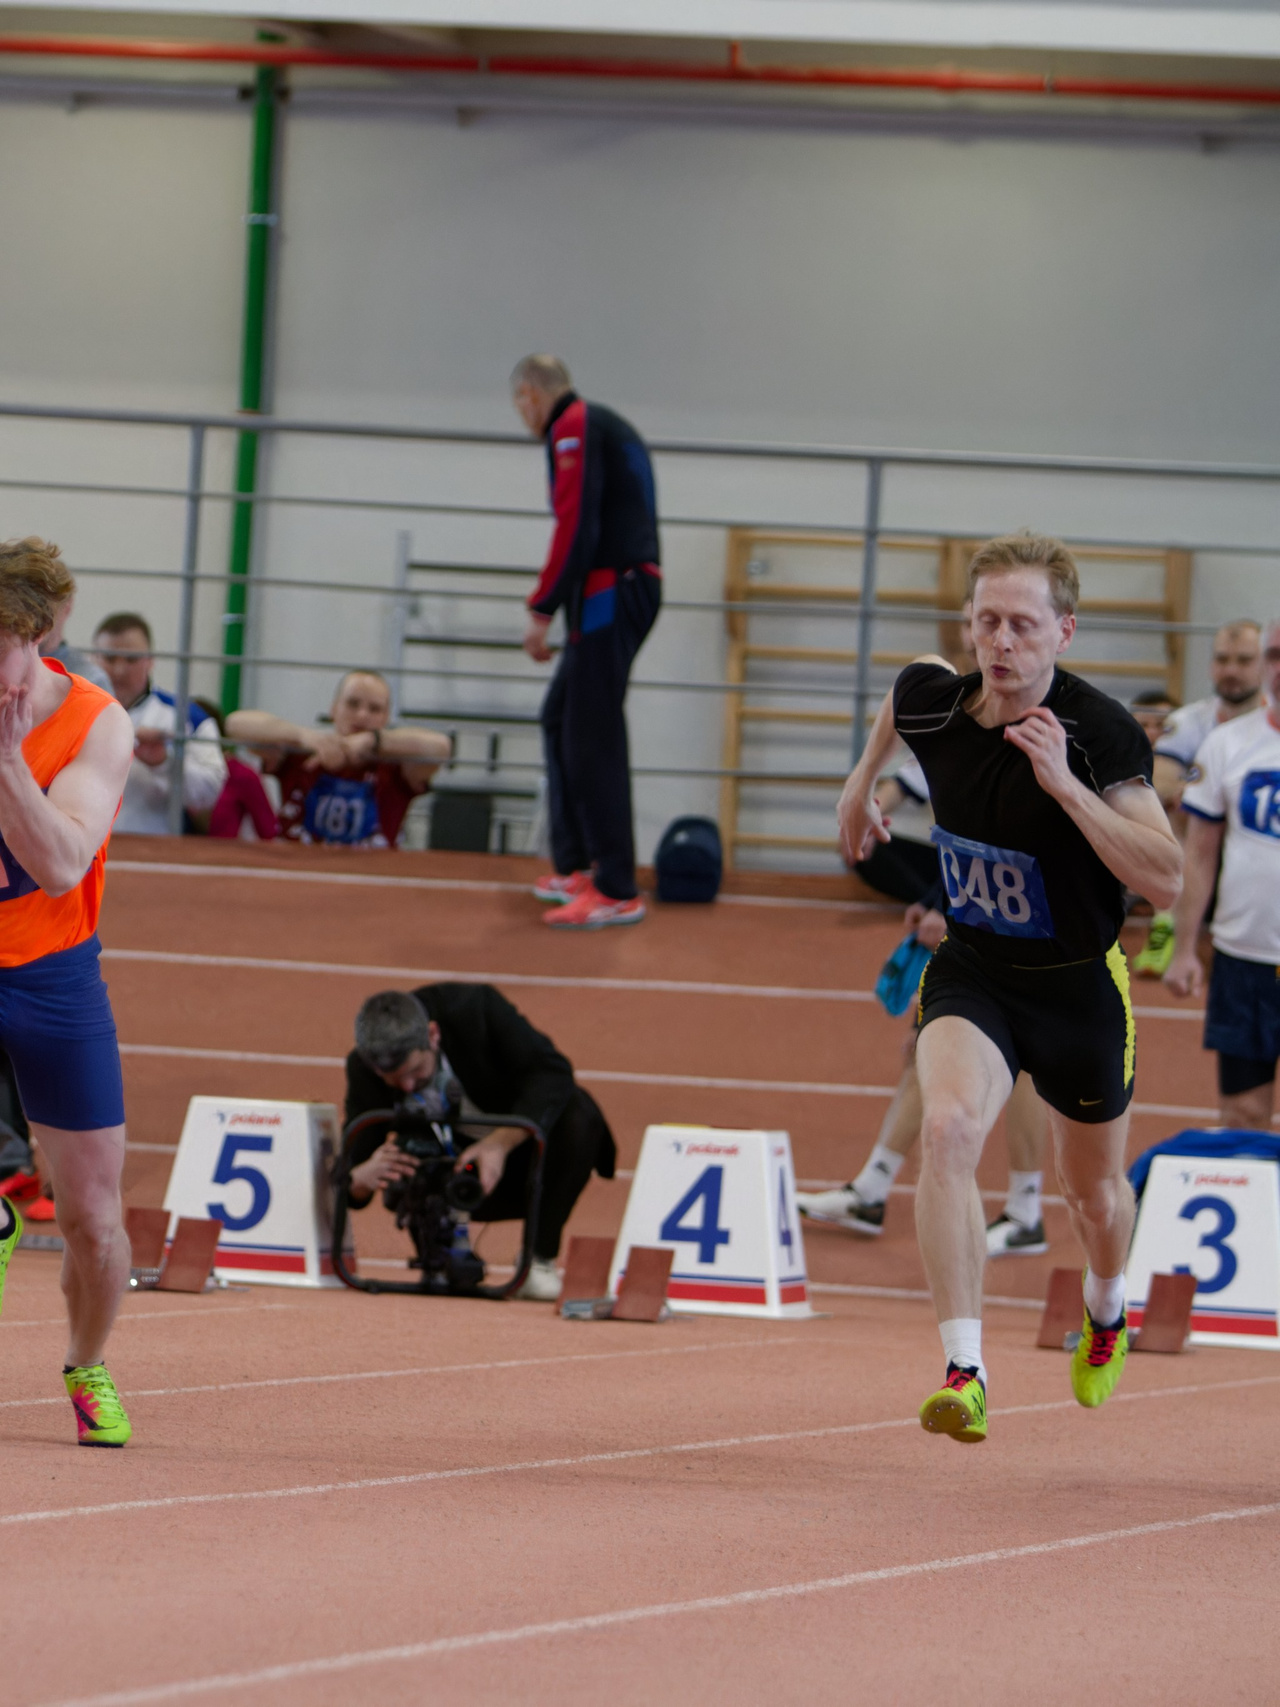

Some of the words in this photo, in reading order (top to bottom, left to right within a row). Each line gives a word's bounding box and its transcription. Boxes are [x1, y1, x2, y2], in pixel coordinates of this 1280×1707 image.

[940, 844, 1031, 924] 048
[206, 1133, 273, 1232] 5
[658, 1164, 731, 1265] 4
[777, 1165, 794, 1267] 4
[1172, 1194, 1238, 1294] 3
